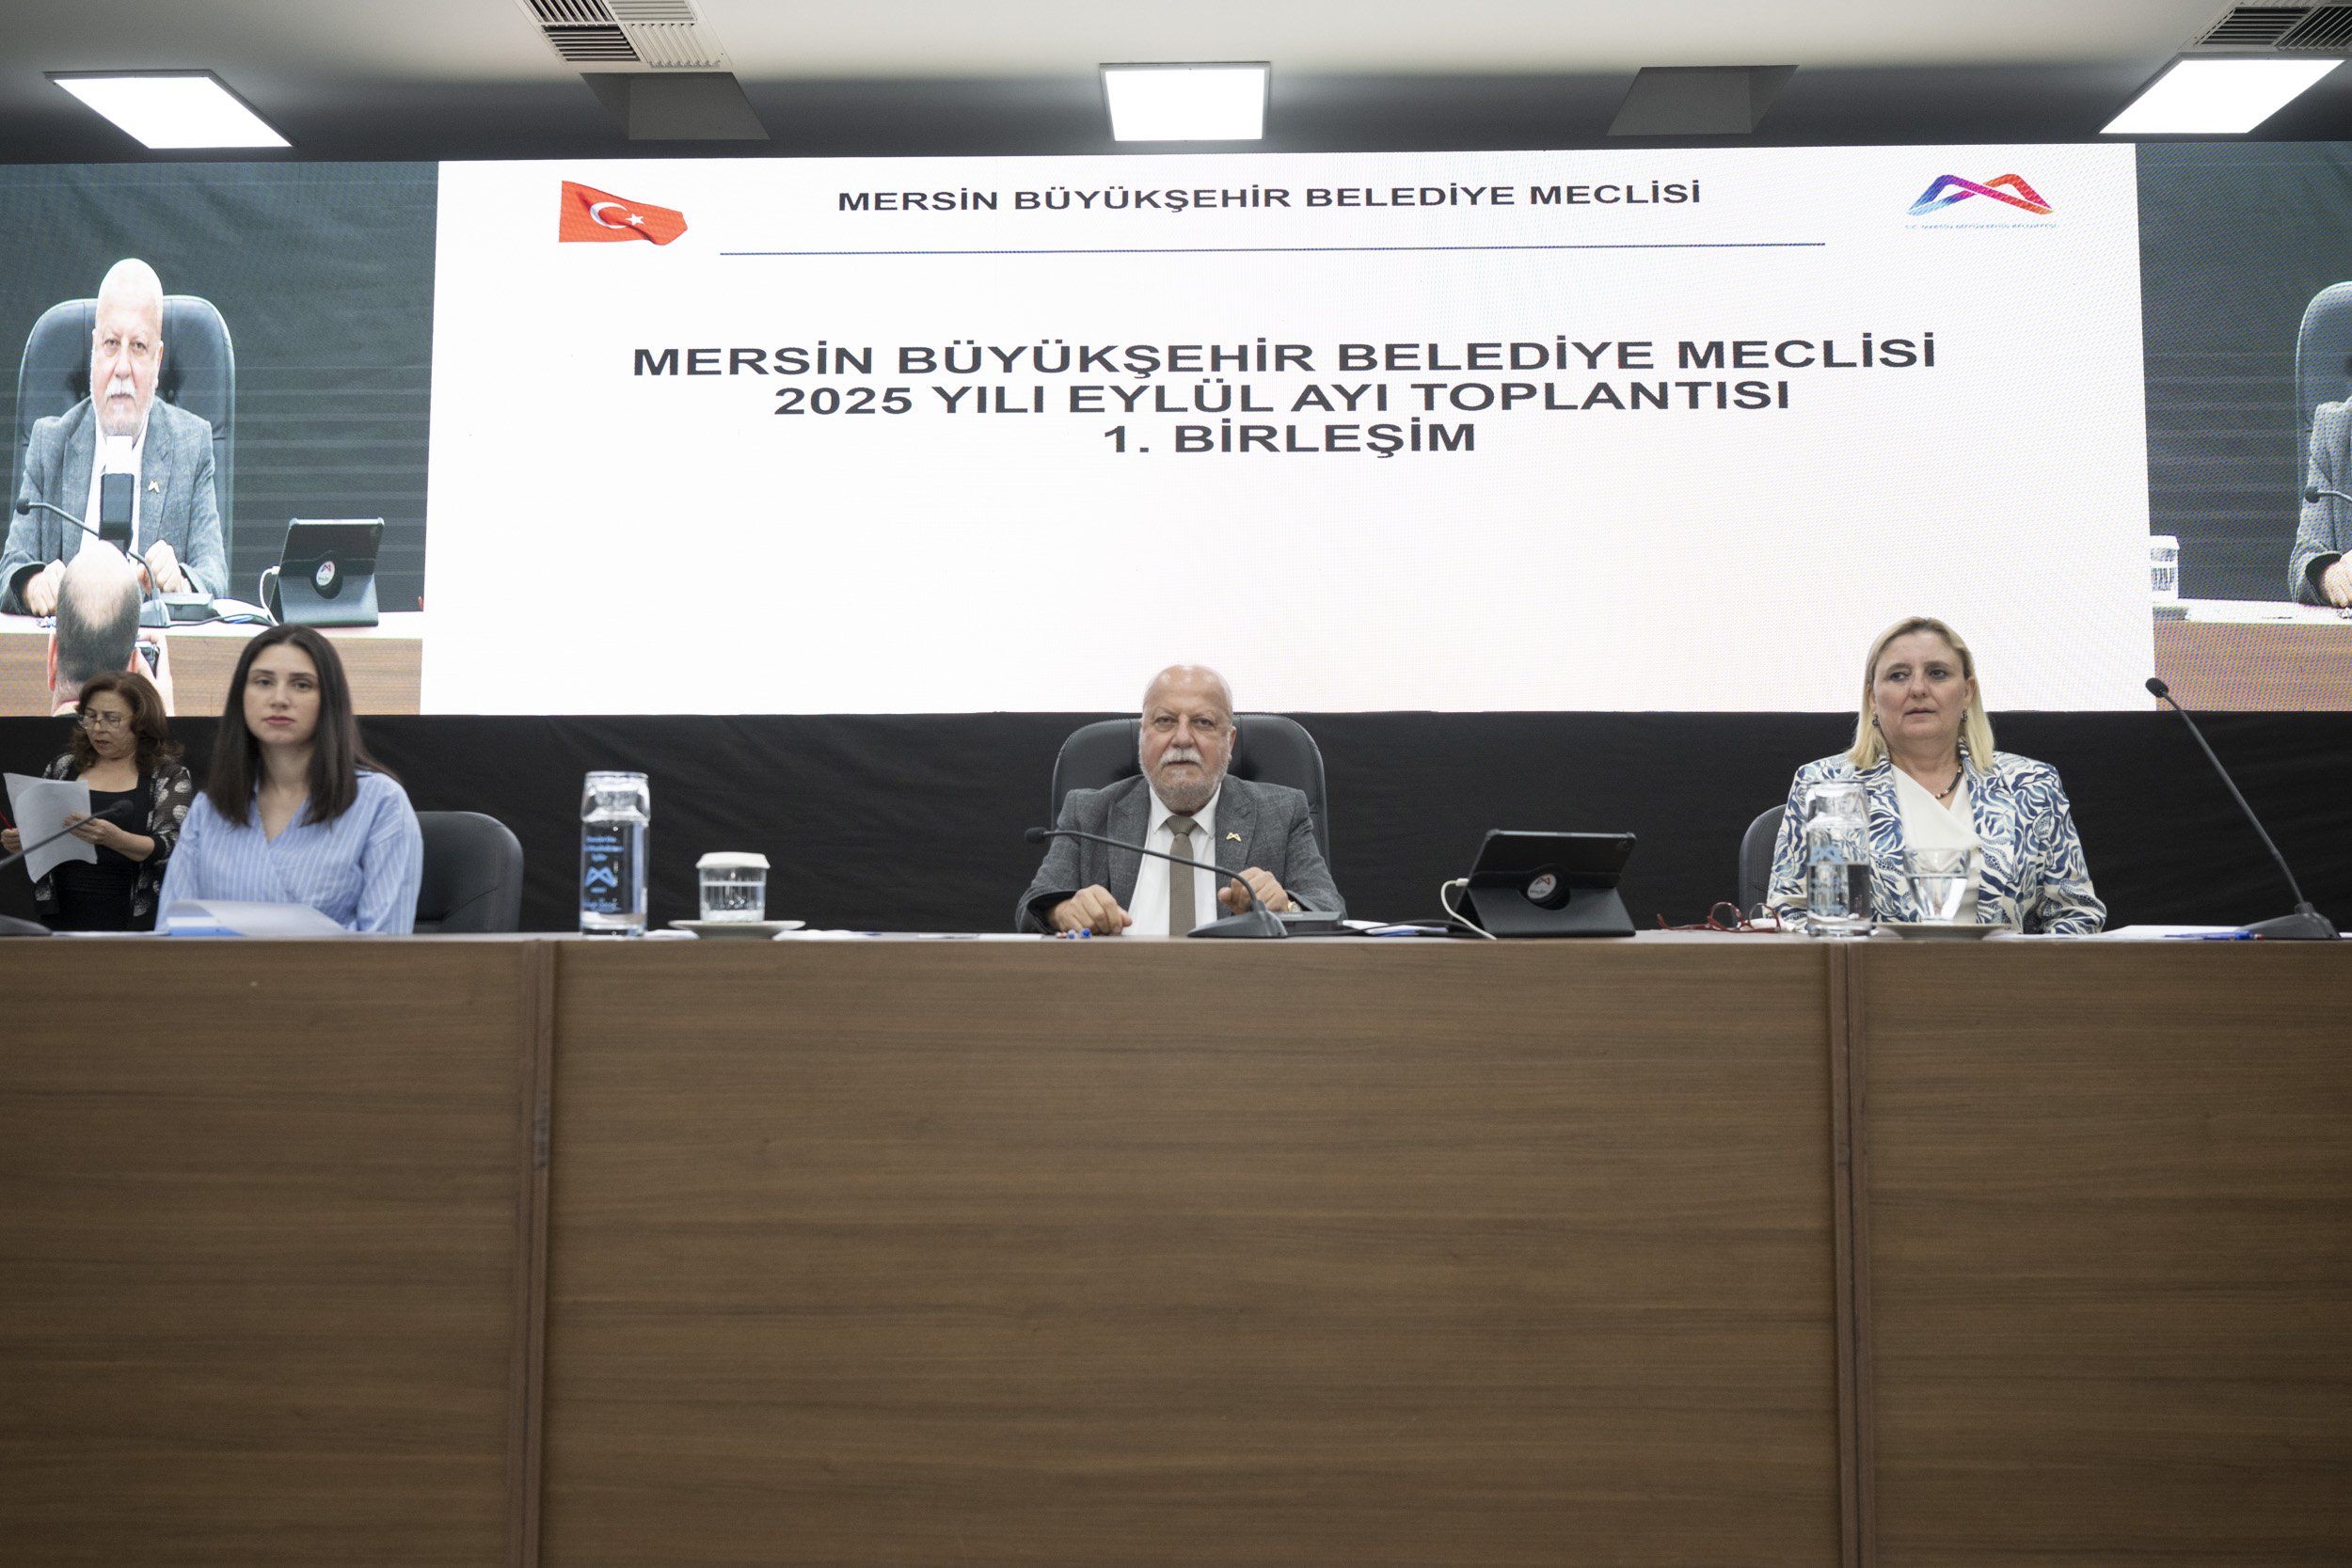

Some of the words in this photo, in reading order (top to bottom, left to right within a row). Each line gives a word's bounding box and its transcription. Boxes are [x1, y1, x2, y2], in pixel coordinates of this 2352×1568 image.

[839, 188, 996, 211] MERSİN
[1015, 184, 1291, 213] BÜYÜKŞEHİR
[1307, 182, 1514, 207] BELEDİYE
[1531, 180, 1699, 204] MECLİSİ
[634, 341, 871, 375] MERSİN
[899, 338, 1315, 379] BÜYÜKŞEHİR
[1340, 336, 1653, 371] BELEDİYE
[1678, 332, 1934, 369] MECLİSİ
[774, 388, 912, 415] 2025
[931, 386, 1043, 413] YILI
[1071, 378, 1273, 412] EYLÜL
[1291, 384, 1387, 411] AYI
[1411, 381, 1788, 411] TOPLANTISI
[1105, 426, 1149, 452] 1.
[1176, 417, 1474, 458] BİRLEŞİM
